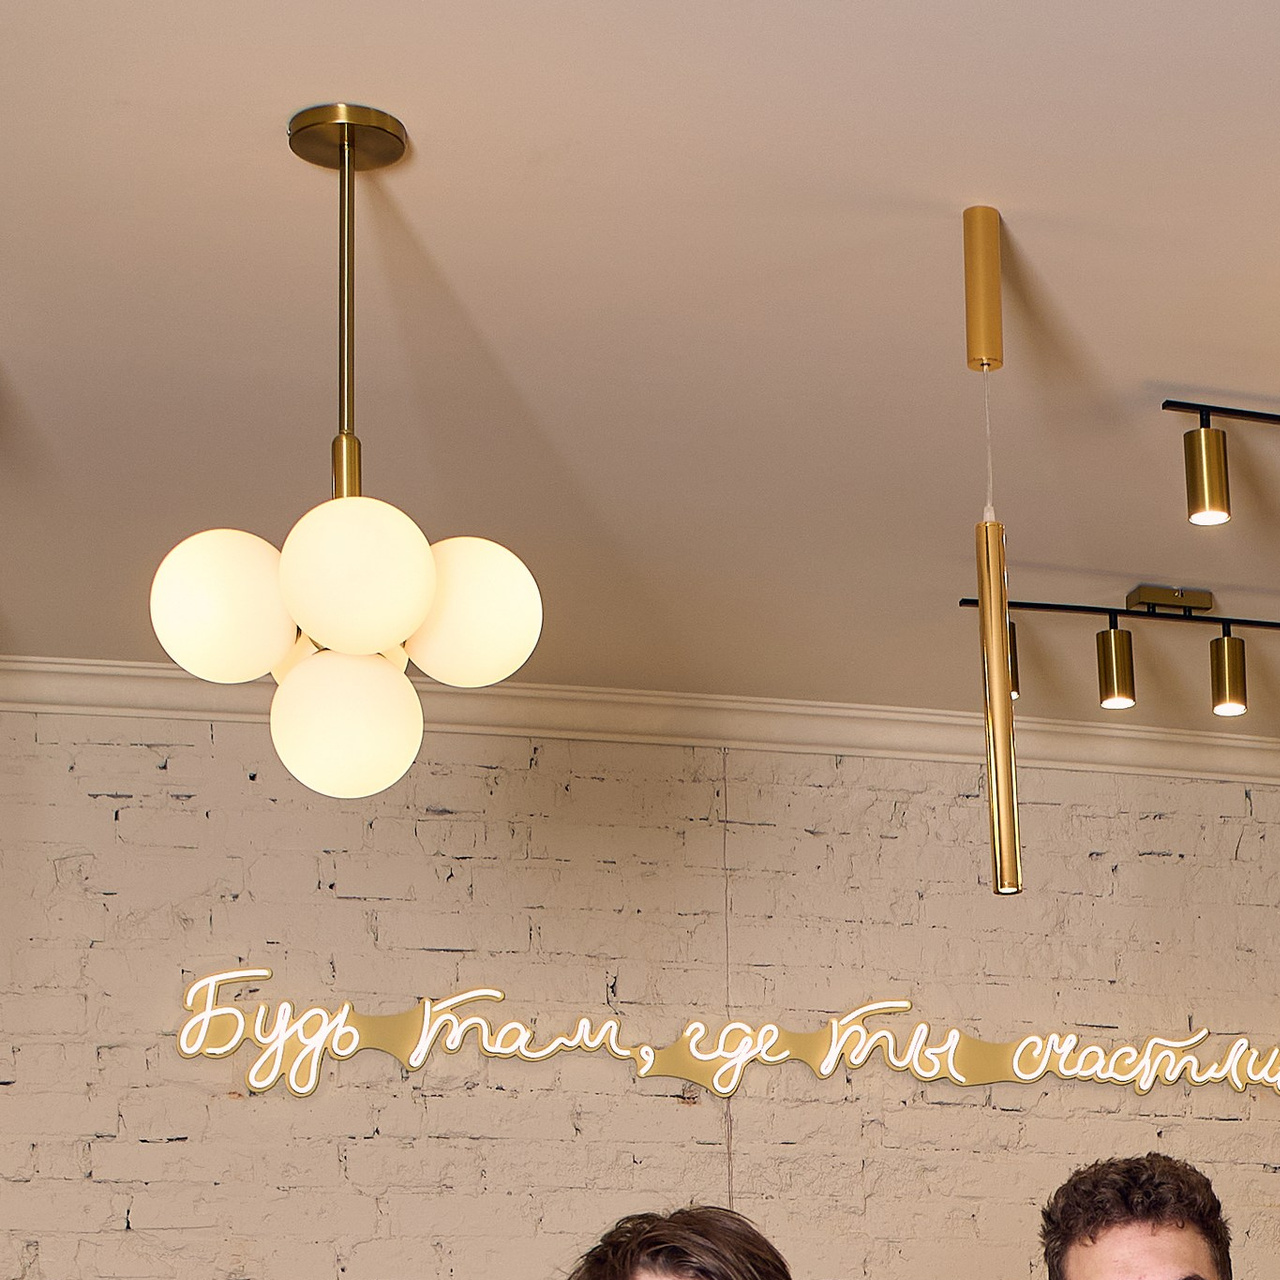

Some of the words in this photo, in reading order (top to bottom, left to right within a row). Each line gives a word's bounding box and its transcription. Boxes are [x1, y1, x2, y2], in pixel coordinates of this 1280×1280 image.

[178, 967, 361, 1095] Будь
[686, 1020, 790, 1095] где
[819, 1000, 967, 1082] ты
